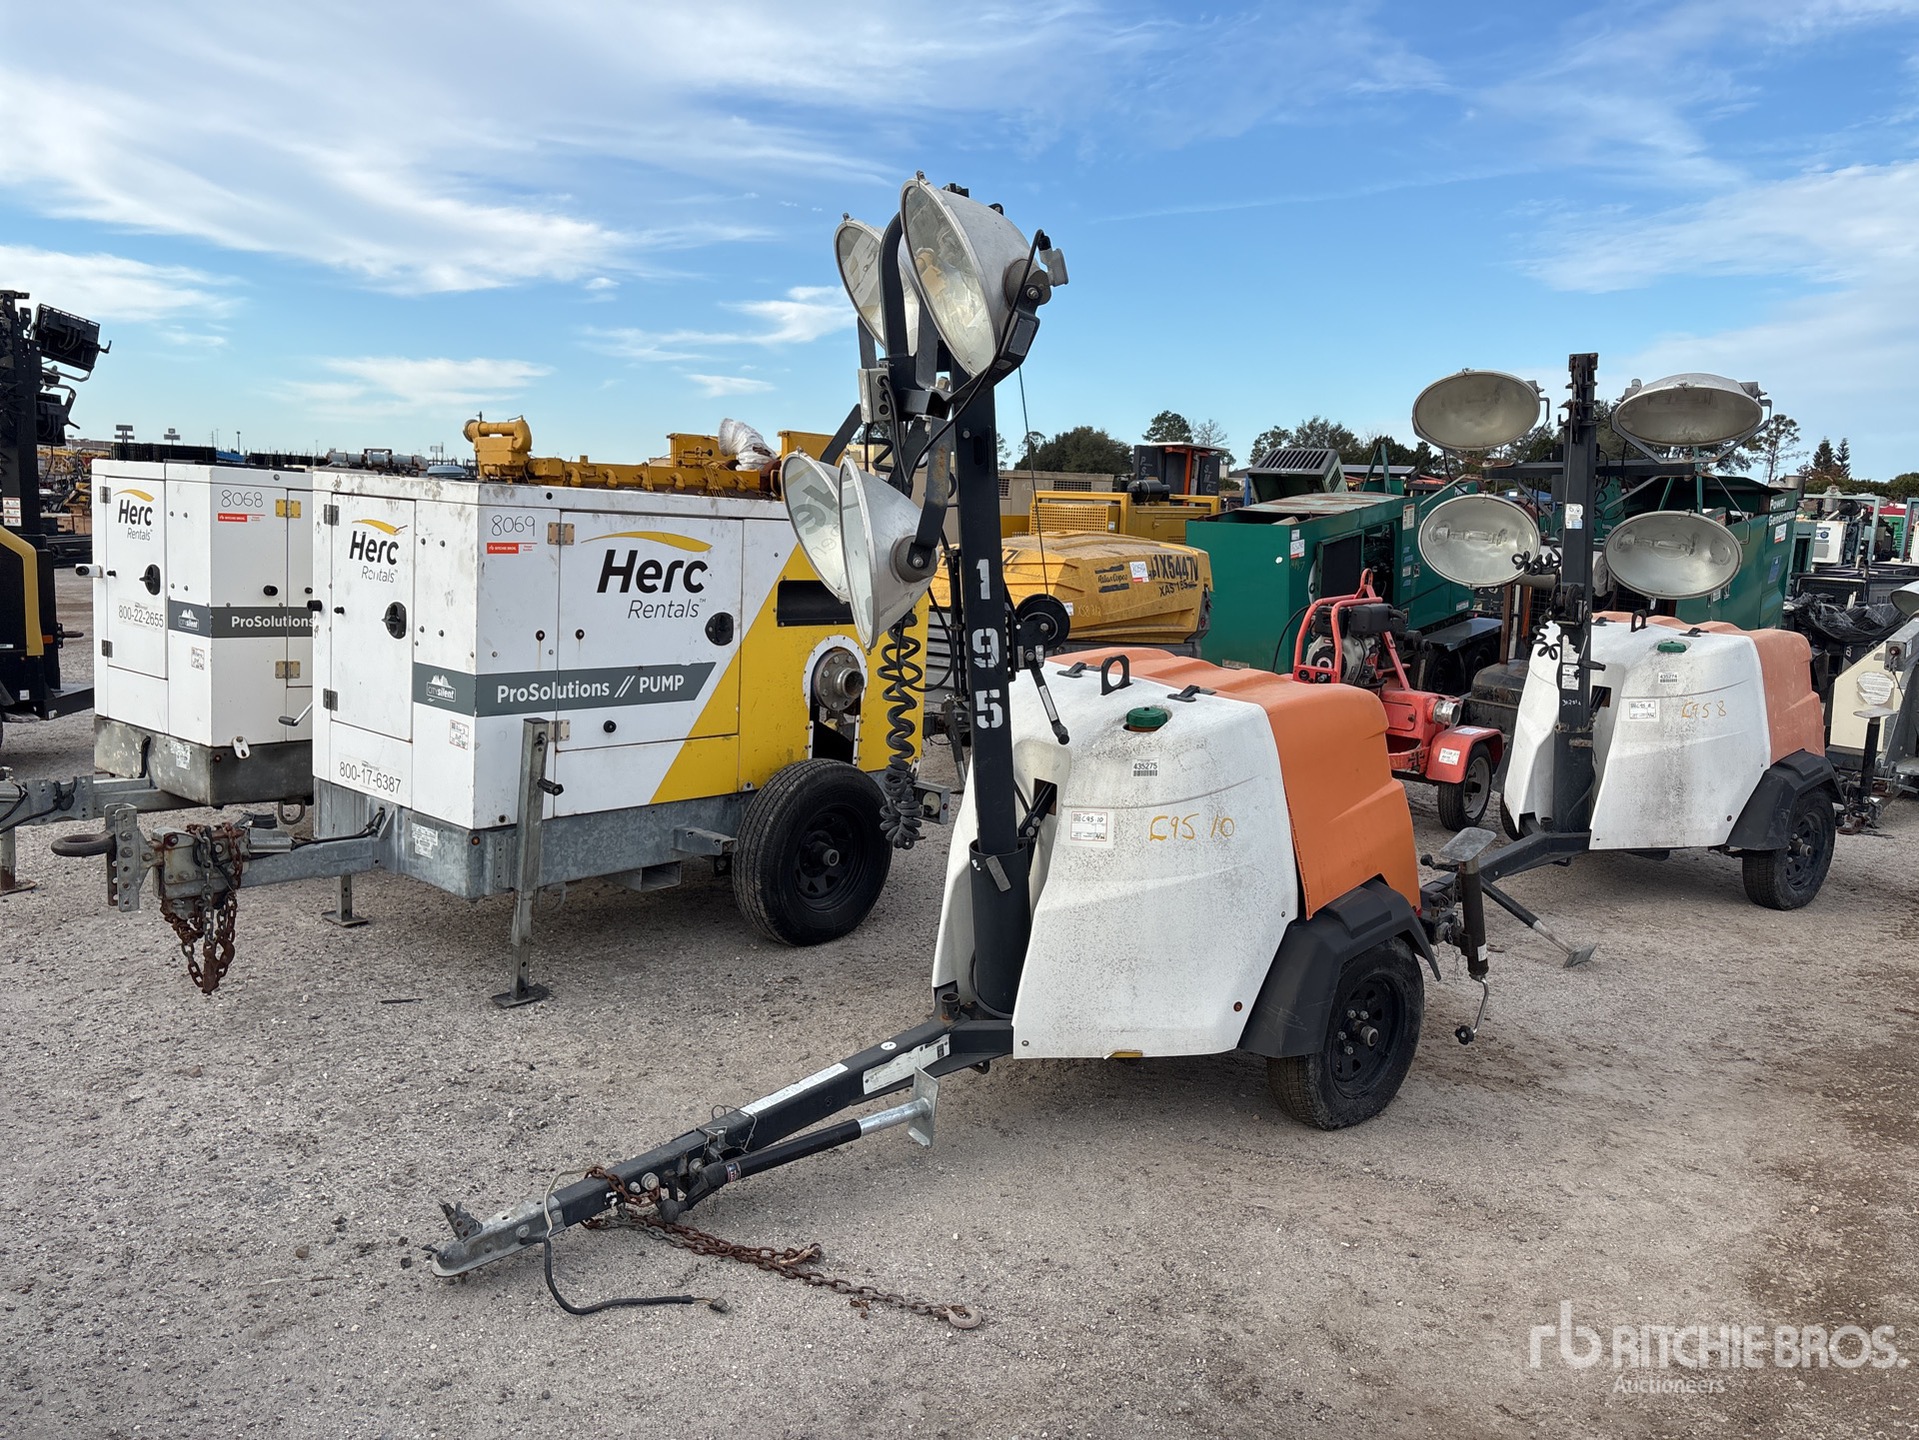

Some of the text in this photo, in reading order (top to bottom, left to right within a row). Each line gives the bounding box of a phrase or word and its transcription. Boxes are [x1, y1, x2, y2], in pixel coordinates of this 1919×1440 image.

[221, 490, 263, 508] 8068
[1770, 497, 1787, 511] Power
[118, 499, 153, 526] Herc
[1768, 510, 1796, 527] Generation
[491, 514, 536, 537] 8069
[349, 530, 399, 565] Herc
[596, 549, 709, 594] Herc
[118, 604, 164, 629] 800-22-2655
[230, 615, 313, 629] ProSolutions
[497, 680, 610, 703] ProSolutions
[639, 674, 685, 693] PUMP
[1716, 700, 1727, 717] 8
[1133, 762, 1158, 770] 435275
[339, 761, 402, 795] 800-17-6387
